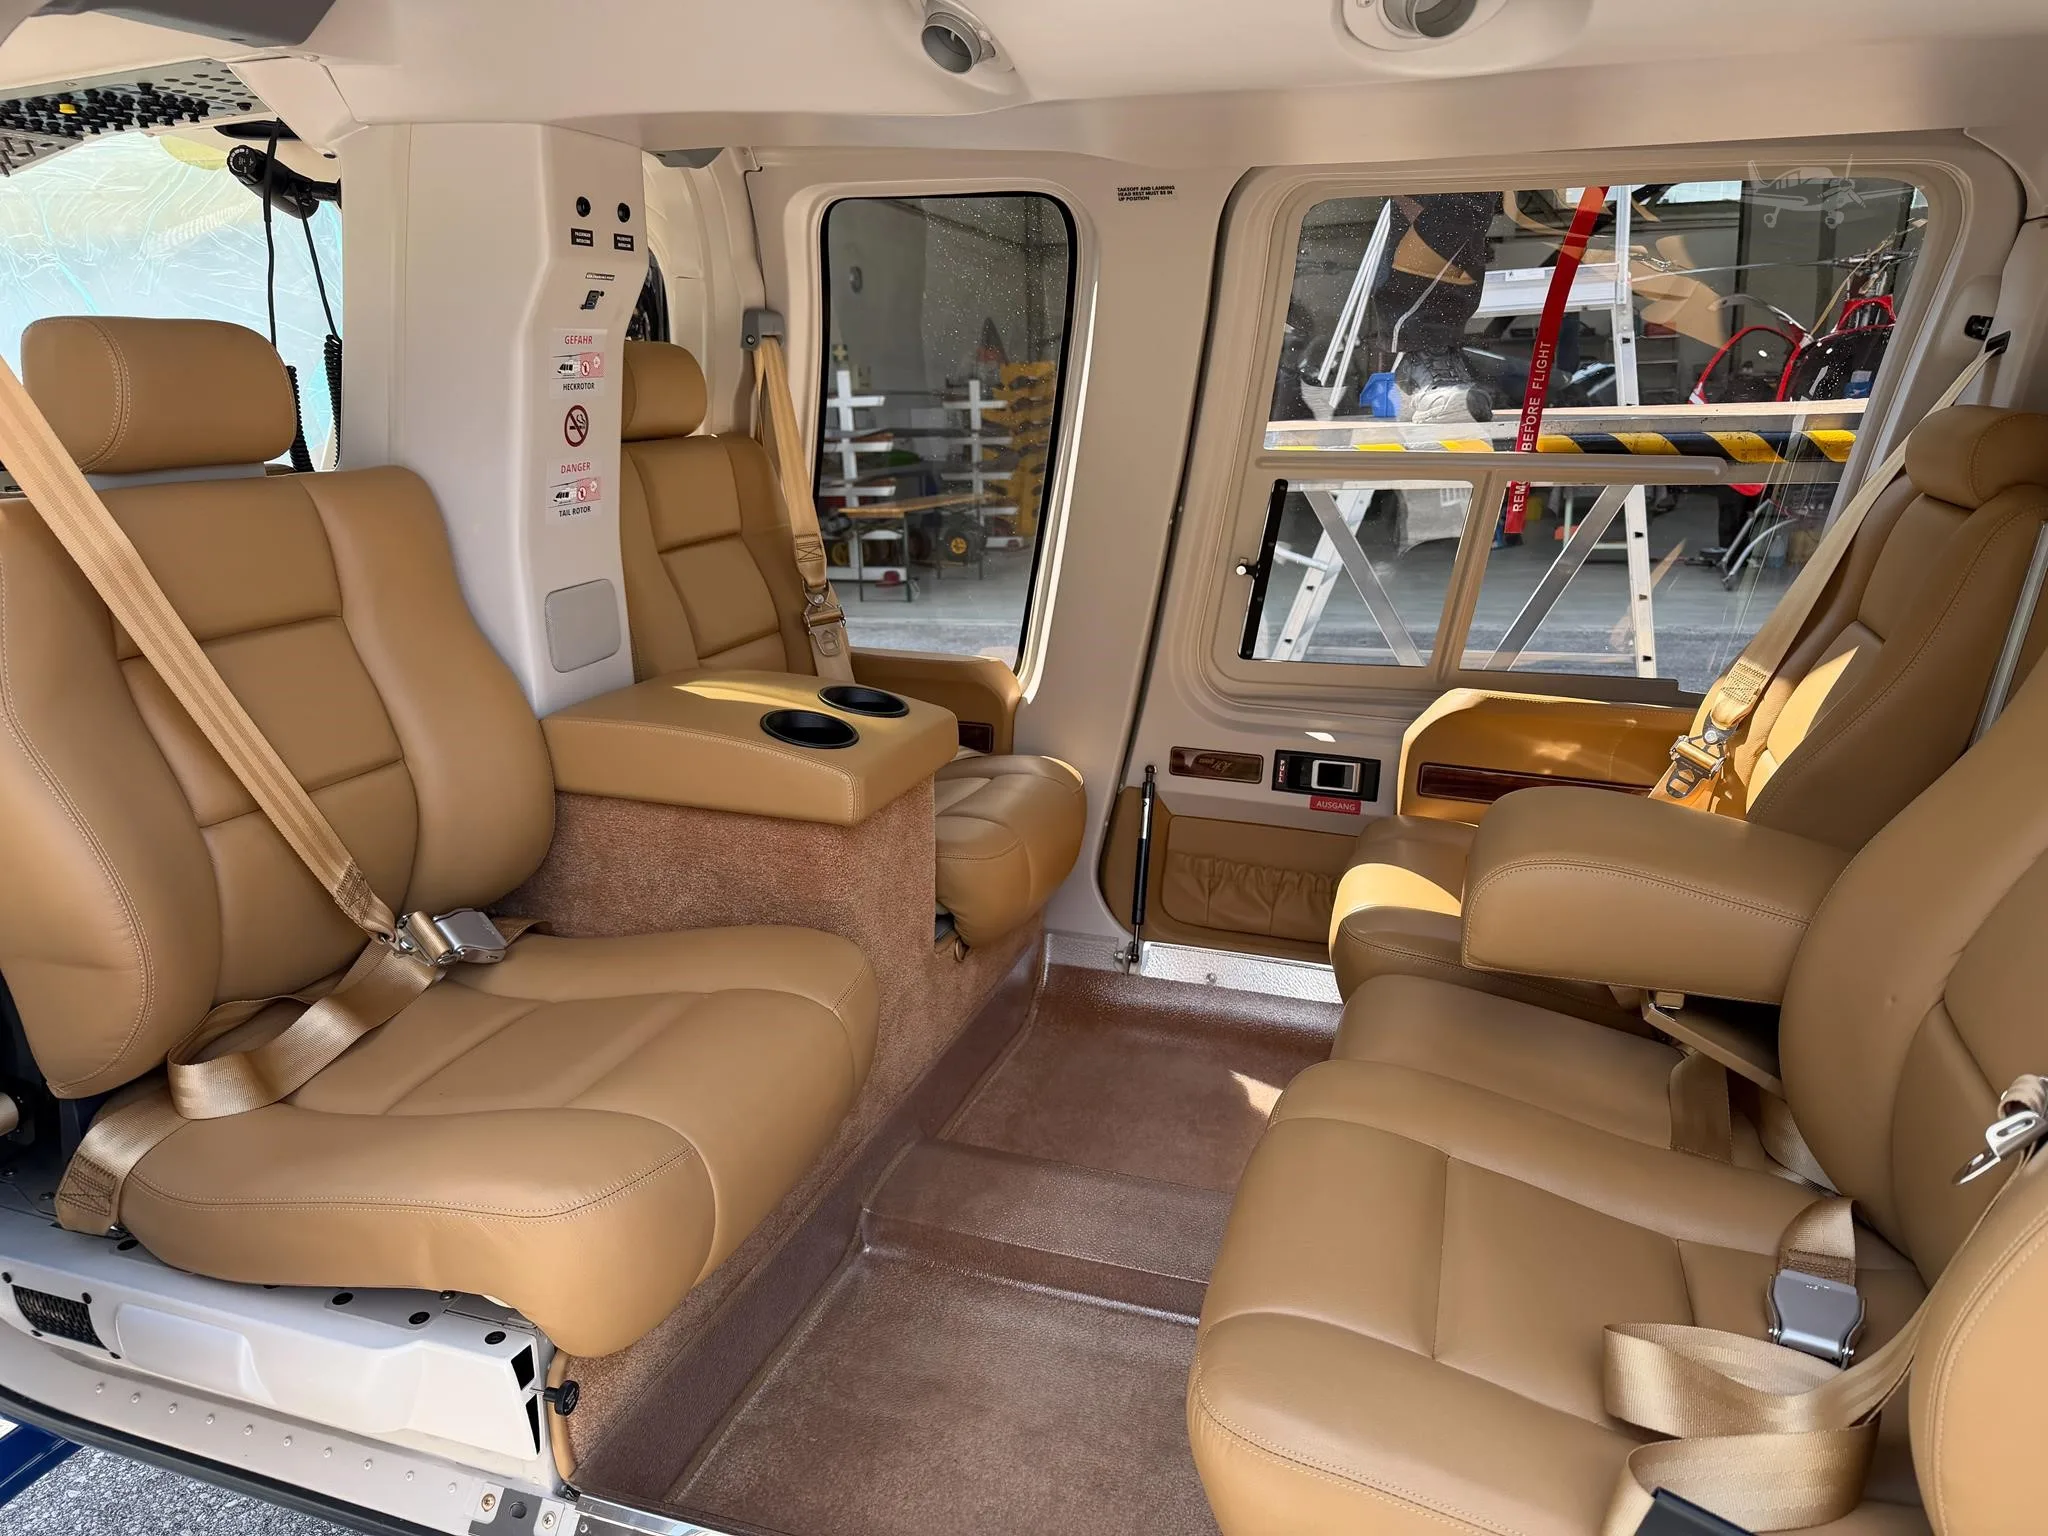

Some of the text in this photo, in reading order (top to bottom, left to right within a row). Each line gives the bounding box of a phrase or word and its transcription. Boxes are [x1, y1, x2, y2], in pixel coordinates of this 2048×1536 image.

[564, 335, 593, 345] GEFAHR
[562, 382, 595, 391] HECKROTOR
[1521, 397, 1541, 452] BEFORE
[1532, 341, 1551, 390] FLIGHT
[561, 461, 591, 474] DANGER
[559, 505, 592, 517] TAIL ROTOR
[1316, 800, 1356, 811] AUSGANG
